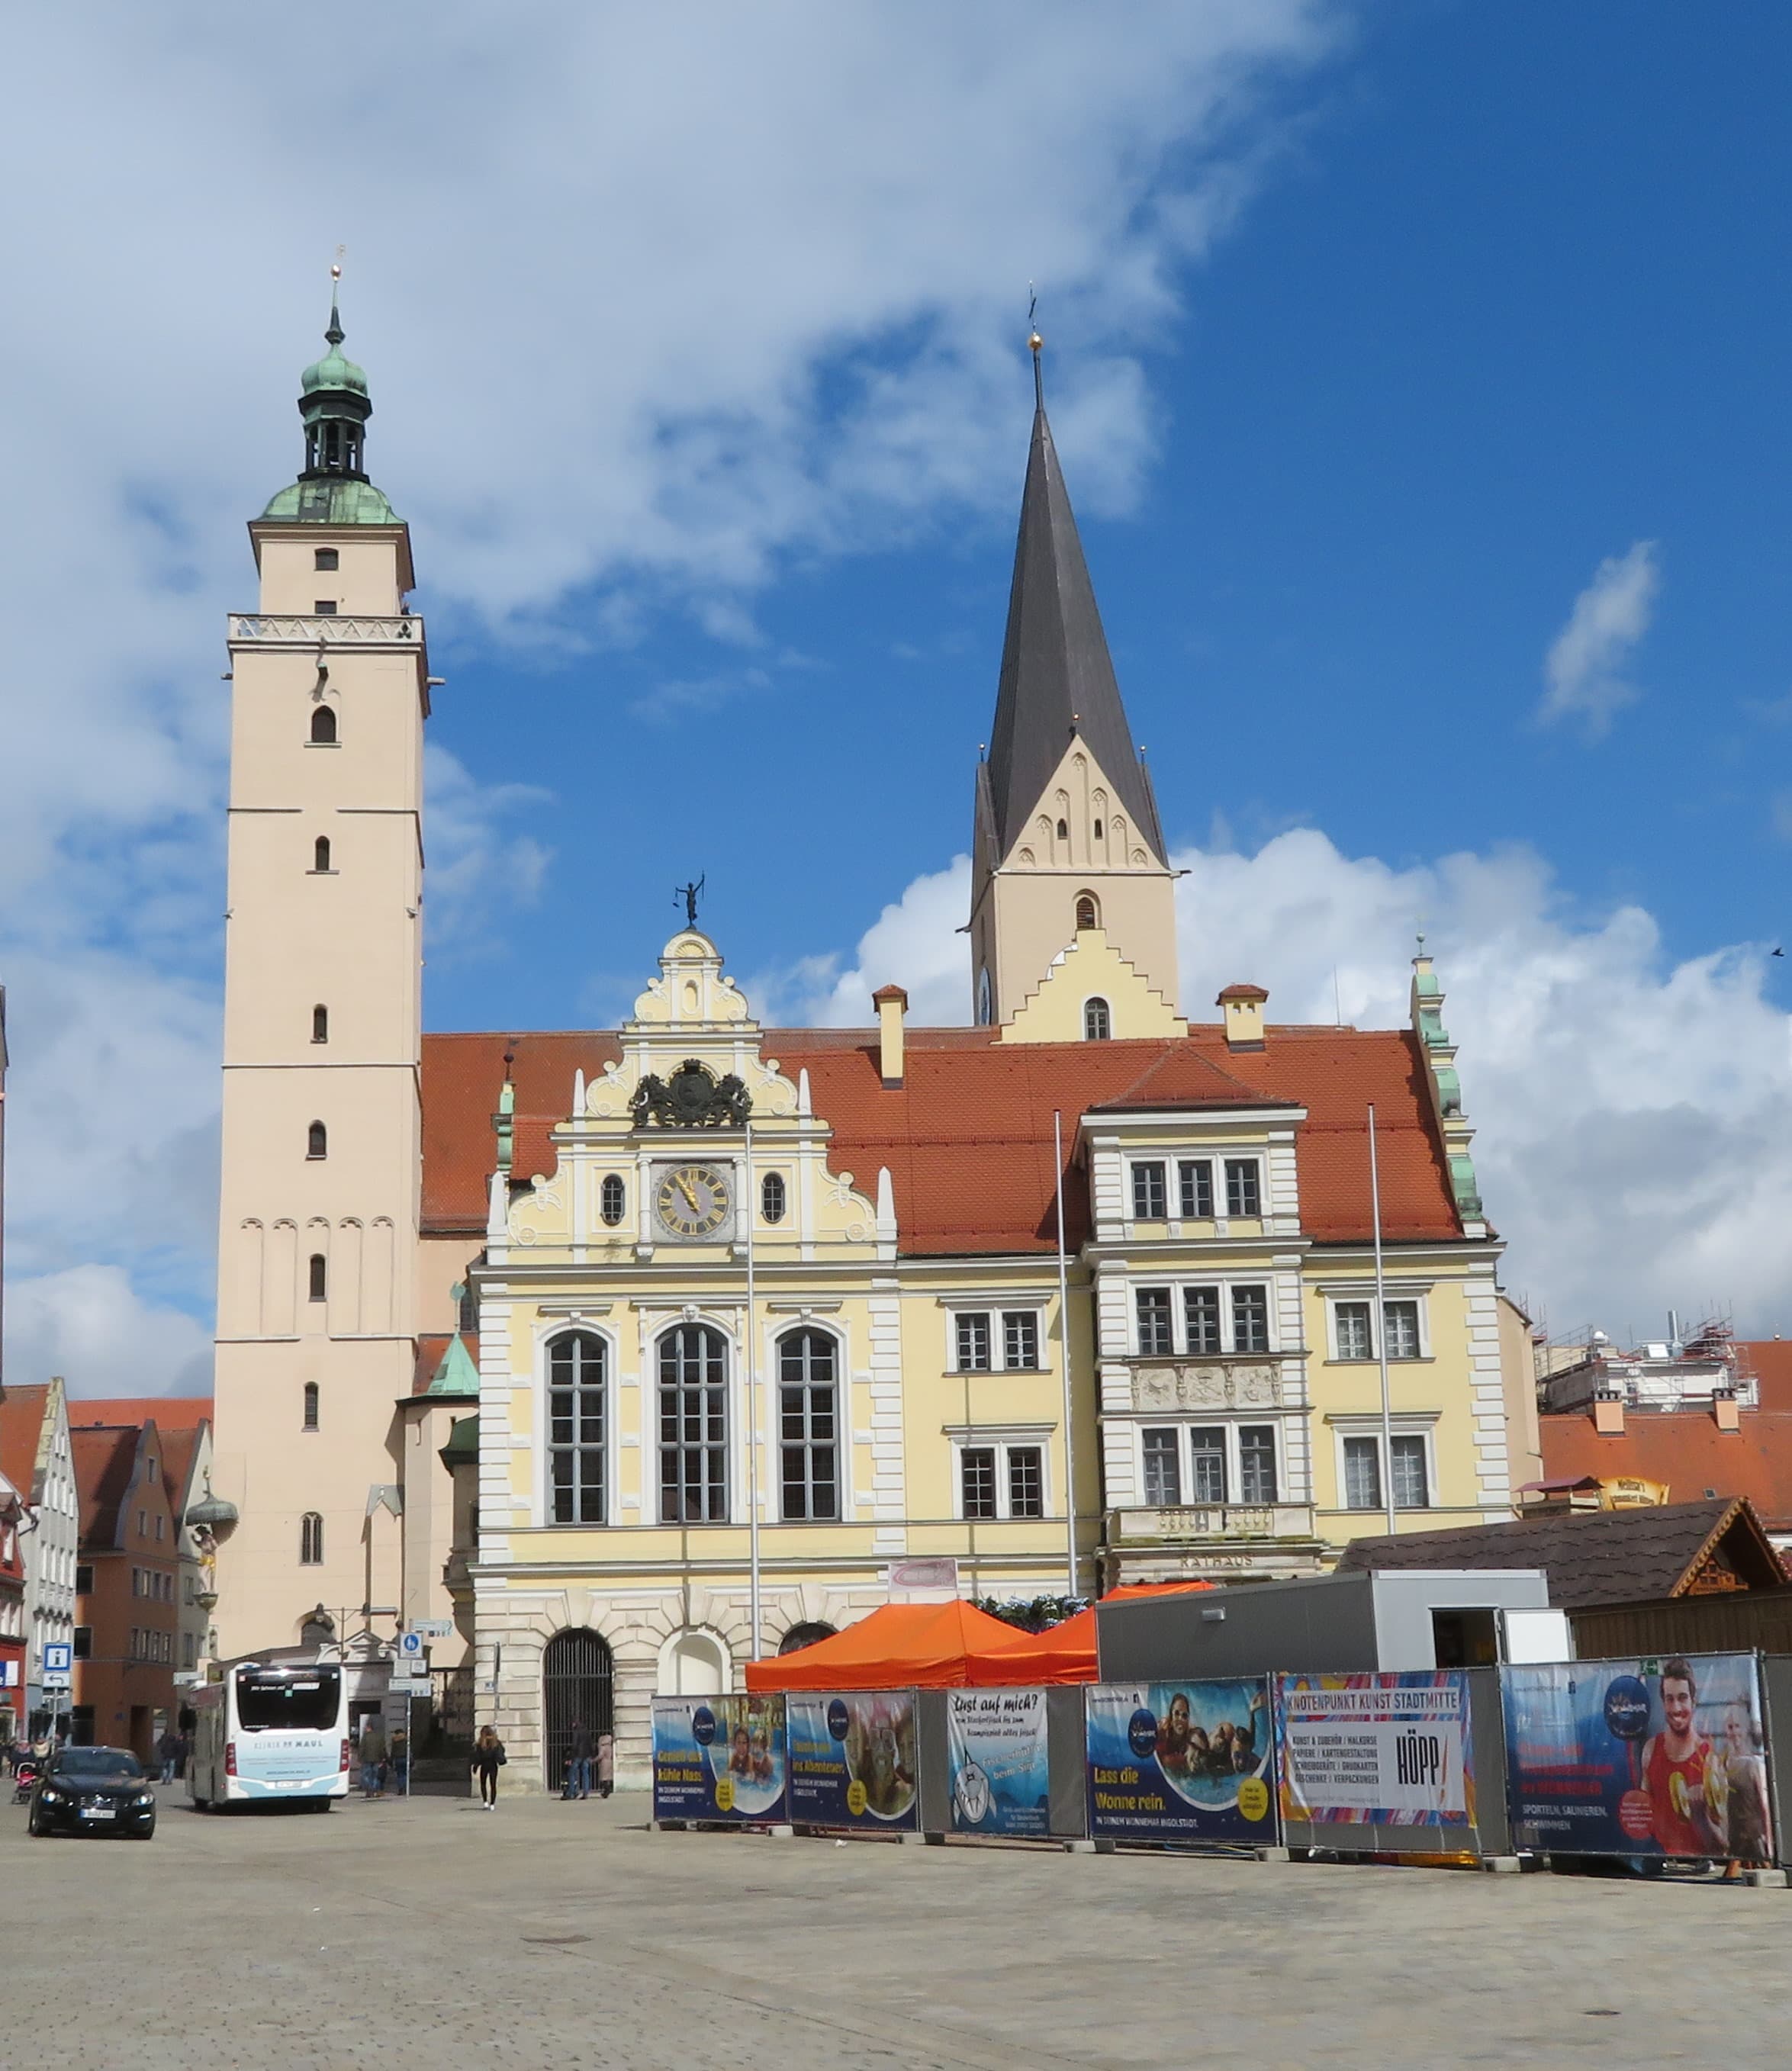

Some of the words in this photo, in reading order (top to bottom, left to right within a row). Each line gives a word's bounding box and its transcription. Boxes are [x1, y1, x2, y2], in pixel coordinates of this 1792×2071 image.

[1181, 1555, 1253, 1568] RATHAUS
[955, 1696, 976, 1713] Lust
[980, 1694, 1001, 1715] auf
[1004, 1693, 1038, 1712] mich?
[1285, 1693, 1356, 1711] KNOTENPUNKT
[1359, 1693, 1391, 1709] KUNST
[1395, 1691, 1457, 1709] STADTMITTE
[1293, 1736, 1311, 1745] KUNST
[1317, 1733, 1343, 1745] ZUBEHÖR
[1094, 1767, 1118, 1784] Lass
[1120, 1767, 1139, 1784] die
[1095, 1792, 1137, 1810] Wonne
[1138, 1793, 1166, 1810] rein.
[1523, 1805, 1562, 1815] SPORTELN,
[1562, 1806, 1608, 1817] SAUNIEREN,
[1104, 1816, 1124, 1825] DEINEM
[1125, 1817, 1160, 1826] WONNEMAR
